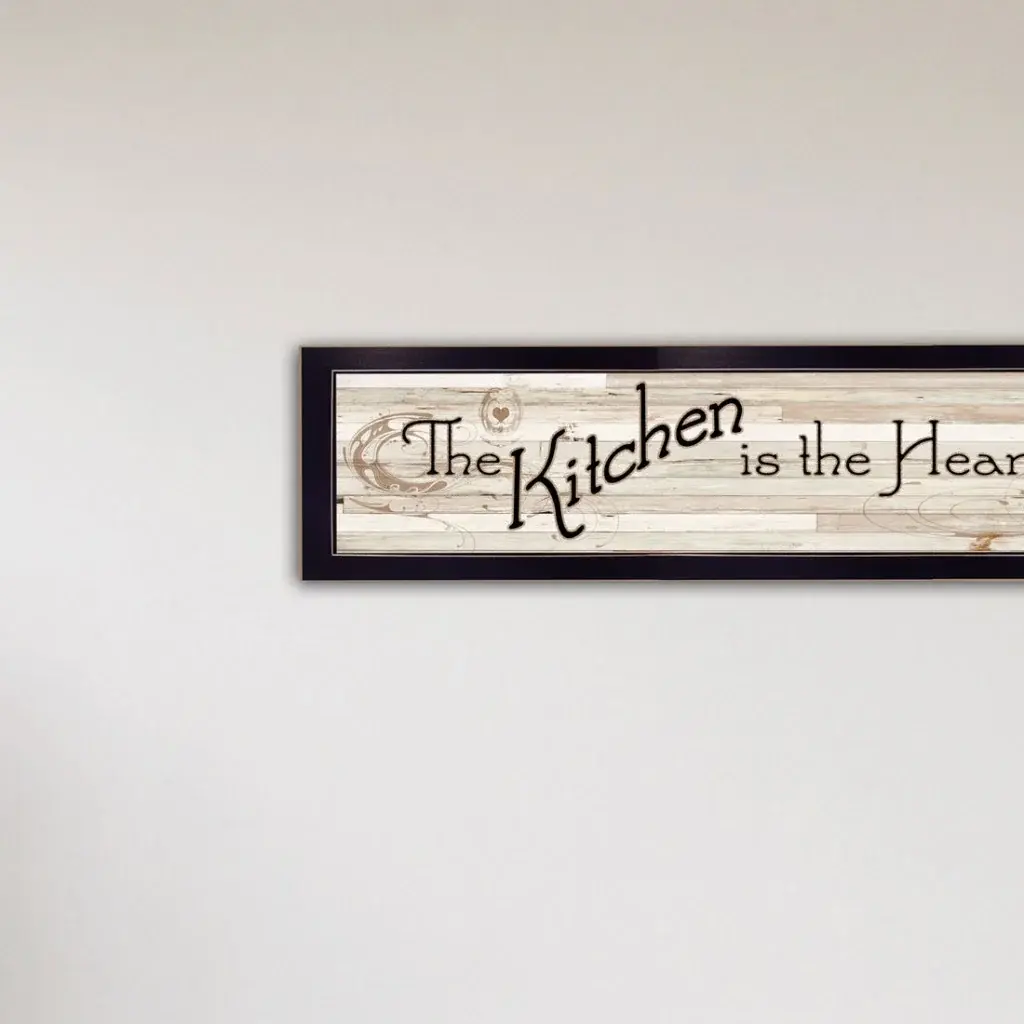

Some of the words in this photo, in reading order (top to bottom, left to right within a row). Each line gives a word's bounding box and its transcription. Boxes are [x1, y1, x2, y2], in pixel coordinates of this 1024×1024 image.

[401, 416, 501, 476] The
[508, 382, 743, 539] Kitchen
[740, 444, 780, 476] is
[799, 420, 871, 476] the
